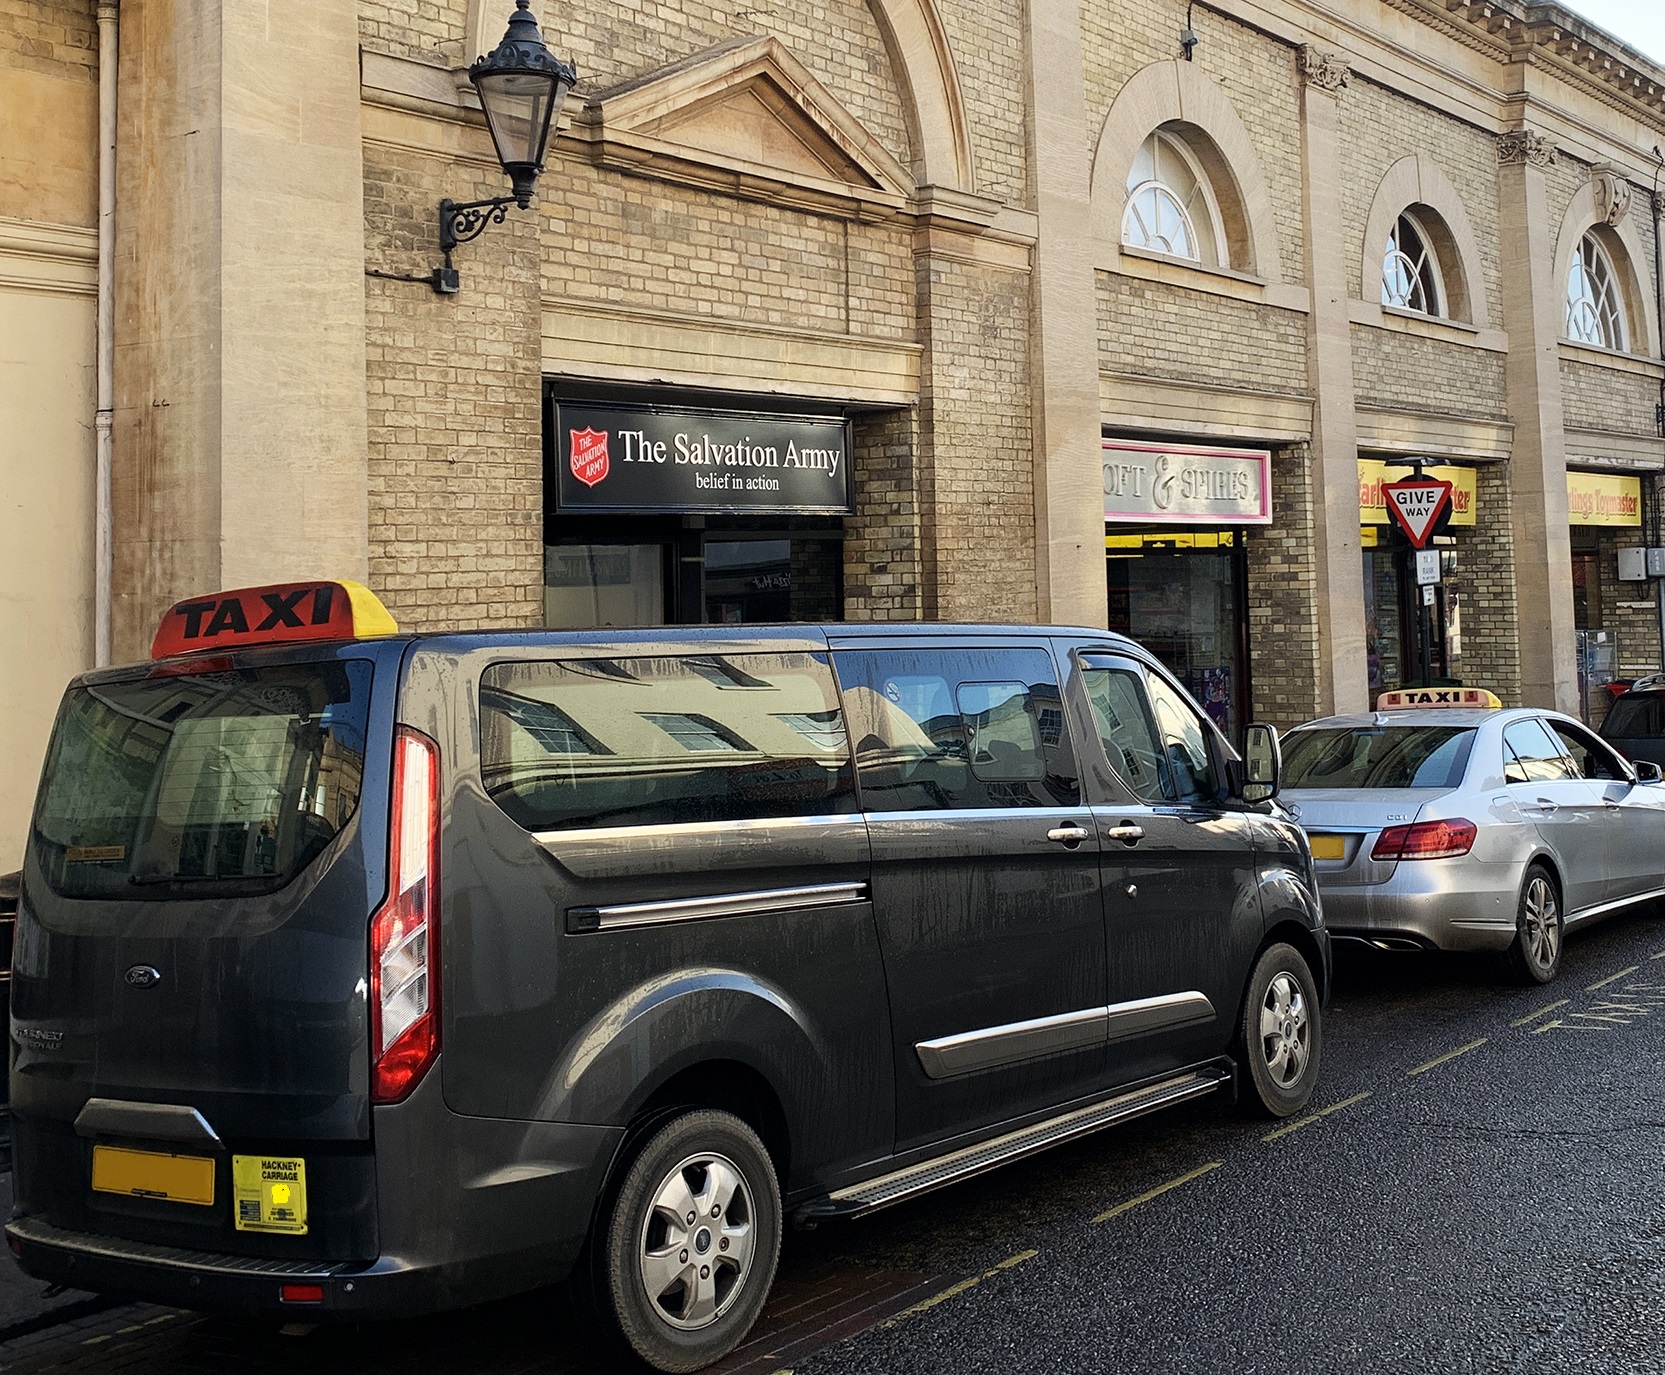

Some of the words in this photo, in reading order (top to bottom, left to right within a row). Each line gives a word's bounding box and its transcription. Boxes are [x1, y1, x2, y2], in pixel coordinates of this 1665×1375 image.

[579, 434, 593, 451] THE
[573, 439, 606, 470] SALVATION
[618, 430, 667, 463] The
[673, 432, 779, 467] Salvation
[782, 439, 840, 477] Army
[585, 455, 605, 478] ARMY
[695, 472, 730, 489] belief
[733, 474, 743, 489] in
[746, 474, 780, 490] action
[1103, 463, 1147, 497] OFT
[1152, 455, 1176, 509] &
[1359, 477, 1387, 508] arli
[1451, 485, 1470, 512] ter
[1396, 490, 1436, 504] GIVE
[1595, 488, 1638, 519] Toymaster
[1405, 507, 1431, 517] WAY
[176, 586, 334, 639] TAXI
[1405, 691, 1460, 703] TAXI
[130, 970, 150, 983] Ford
[261, 1160, 298, 1171] HACKNEY
[261, 1171, 298, 1181] CARRIAGE
